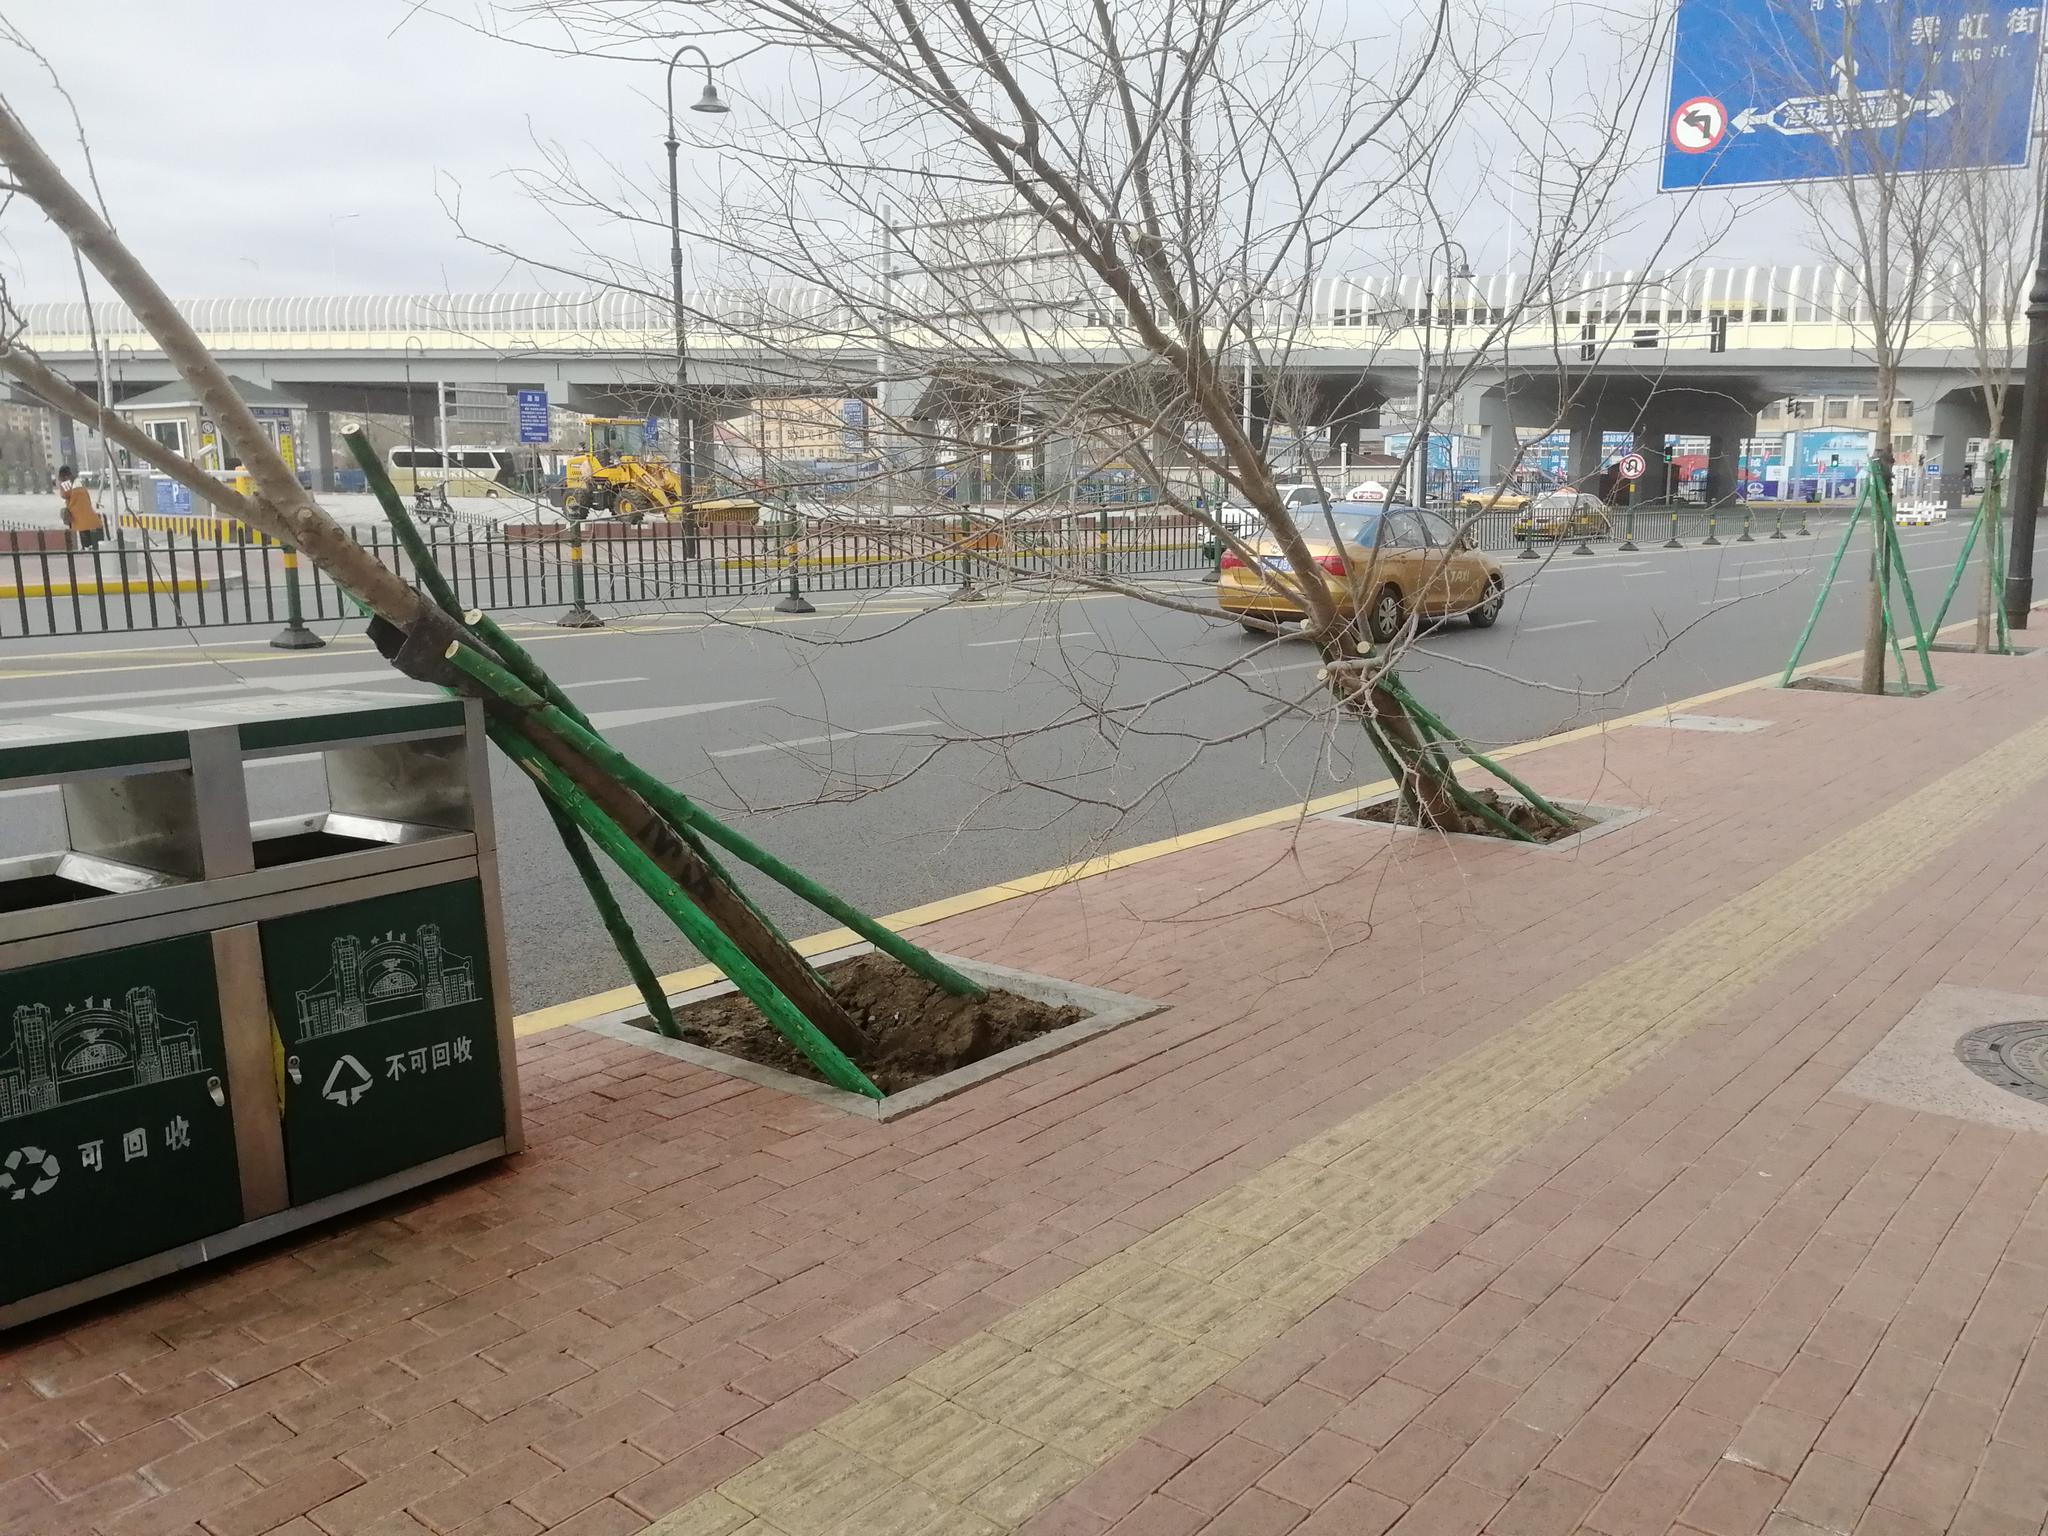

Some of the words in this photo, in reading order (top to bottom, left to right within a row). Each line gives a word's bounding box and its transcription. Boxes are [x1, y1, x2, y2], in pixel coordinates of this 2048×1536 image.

[1450, 569, 1471, 583] TAXI
[385, 1035, 473, 1081] 不可回收
[77, 1115, 191, 1172] 可回收
